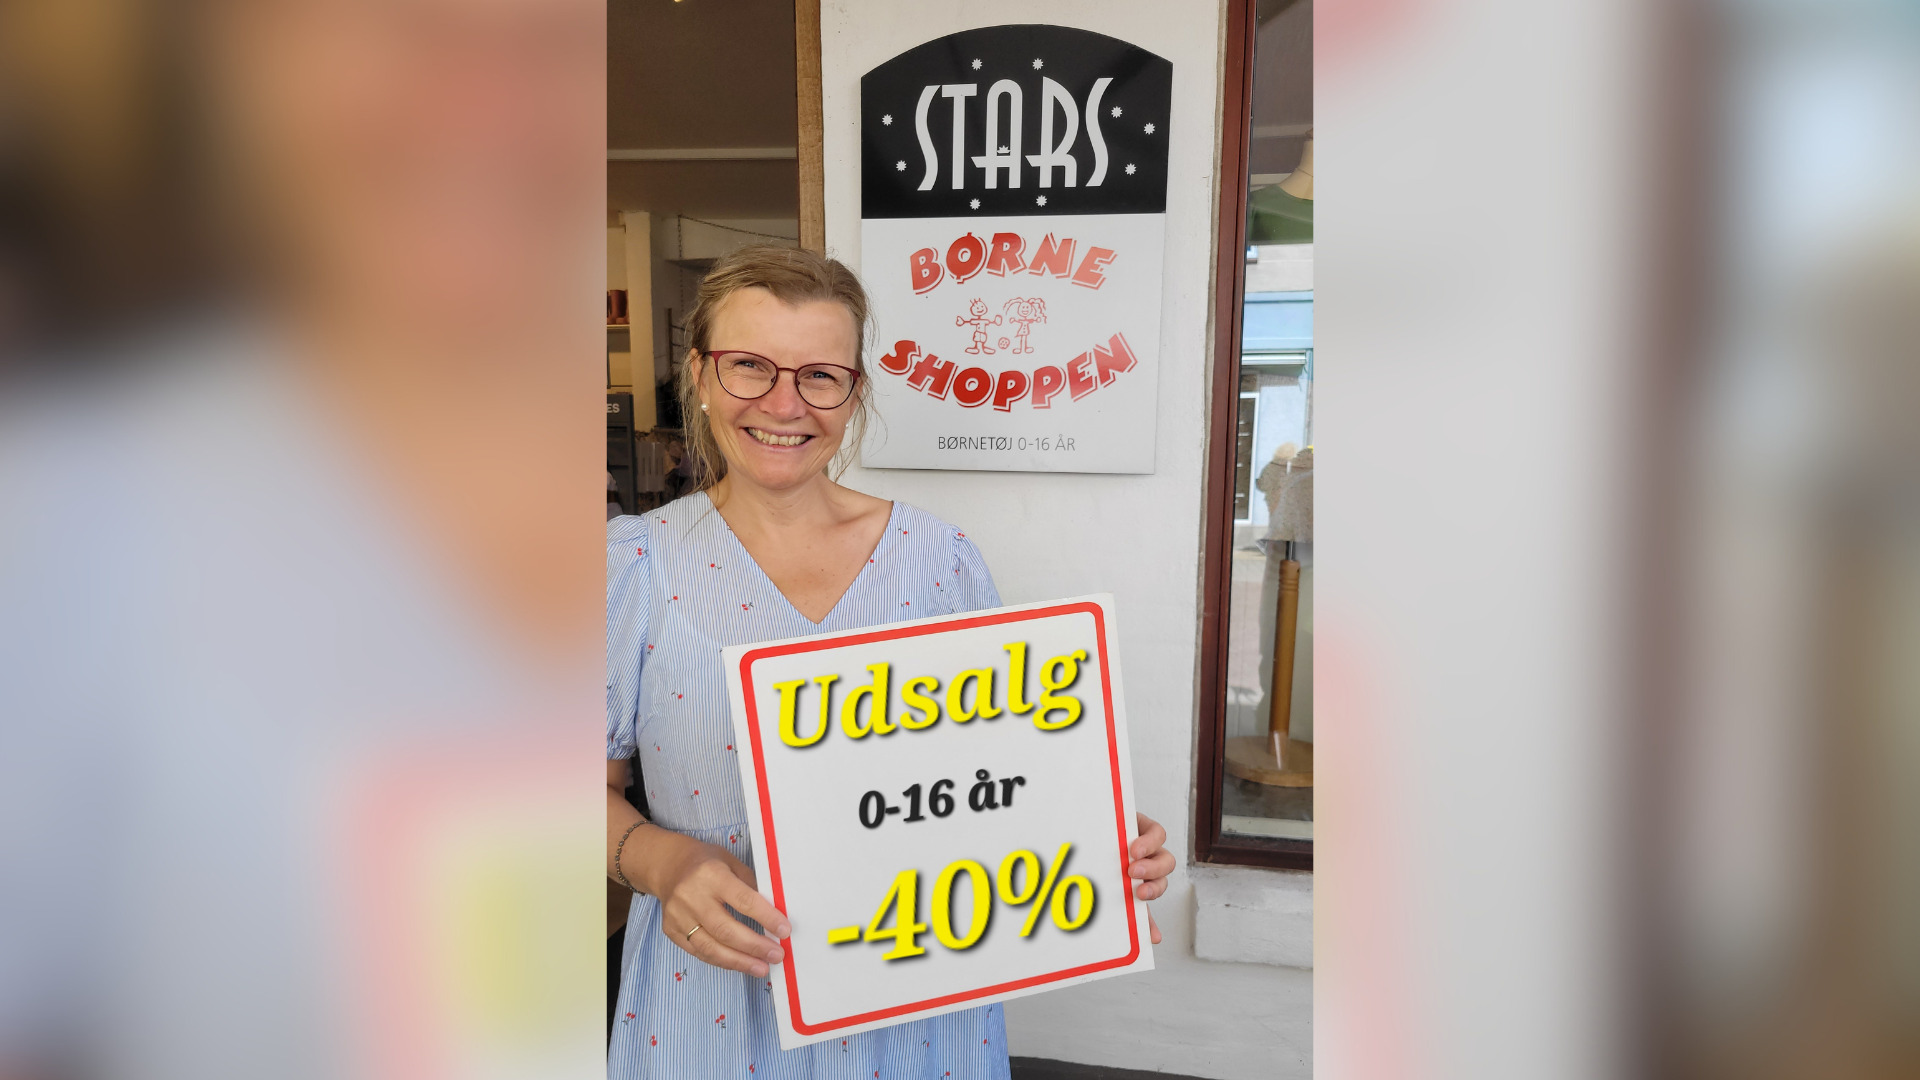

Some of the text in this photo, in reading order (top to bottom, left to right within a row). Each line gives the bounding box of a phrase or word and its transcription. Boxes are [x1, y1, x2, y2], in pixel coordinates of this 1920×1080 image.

[914, 76, 1113, 191] STARS
[910, 231, 1117, 295] BØRNE
[878, 332, 1139, 413] SHOPPEN
[938, 433, 1076, 451] BØRNETØJ 0-16 ÅR
[773, 641, 1088, 748] Udsalg
[858, 768, 1026, 828] 0-16 år
[827, 841, 1097, 962] -40%
